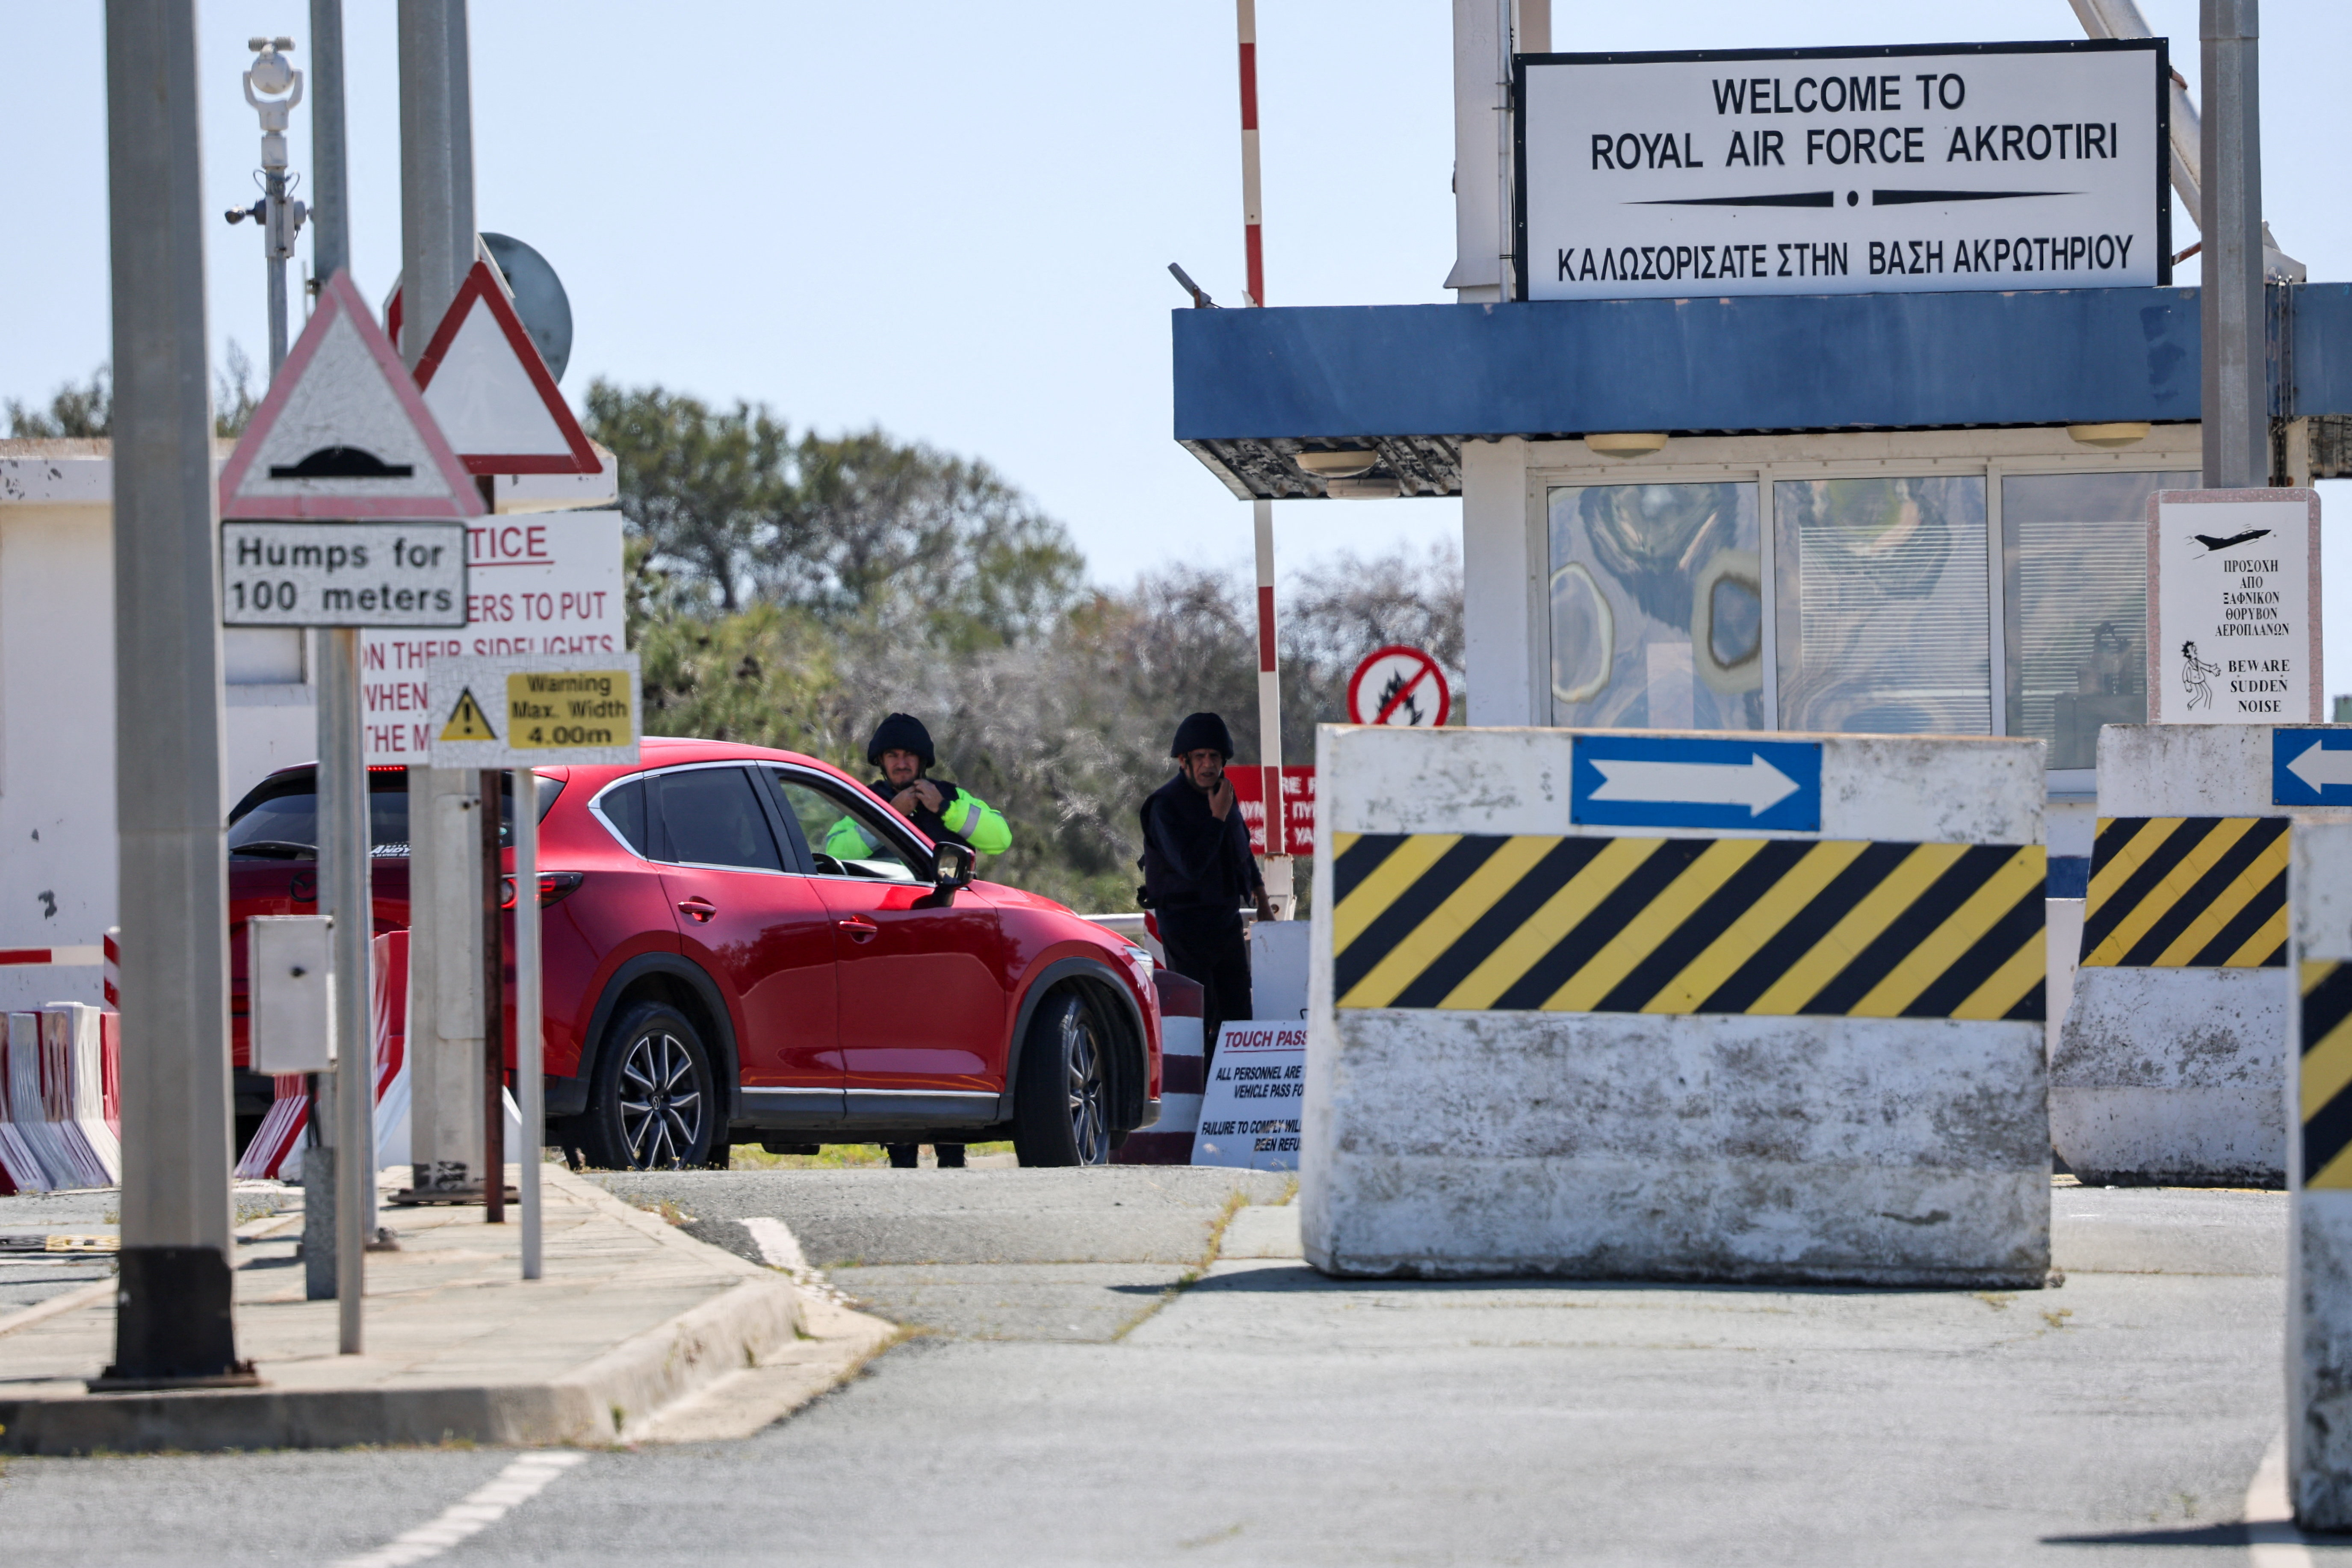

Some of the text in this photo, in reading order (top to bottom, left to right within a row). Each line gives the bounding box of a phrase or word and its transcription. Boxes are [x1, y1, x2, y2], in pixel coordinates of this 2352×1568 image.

[1712, 73, 1965, 115] WELCOME TO
[1592, 122, 2117, 170] ROYAL AIR FORCE AKROTIRI
[1558, 234, 2133, 282] ΚΑΛΩΣΟΡΙΣΑΤΕ ΣΤΗΝ ΒΑΣΗ ΑΚΡΩΤΗΡΙΟΥ
[466, 526, 547, 558] TICE
[237, 537, 443, 573] Humps for
[2224, 560, 2278, 573] ΠΡΟΣΟΧΗ
[2240, 576, 2263, 588] ΑΠΟ
[232, 580, 452, 612] 100 meters
[2223, 591, 2279, 604] ΞΑΦΝΙΚΟΝ
[521, 593, 553, 620] TO
[561, 591, 606, 620] PUT
[2225, 608, 2277, 620] ΘΟΡΥΒΟΝ
[2215, 623, 2289, 636] ΑΕΡΟΠΛΑΝΩΝ
[2228, 659, 2290, 672] BEWARE
[527, 674, 611, 696] Warning
[2231, 679, 2287, 692] SUDDEN
[512, 700, 628, 718] Max. Width
[2238, 700, 2281, 712] NOISE
[527, 726, 612, 744] 4.00m
[1225, 1030, 1273, 1048] TOUCH
[1216, 1065, 1302, 1081] ALL PERSONNEL ARE
[1234, 1084, 1304, 1098] VEHICLE PASS FO
[1201, 1121, 1236, 1136] FAILURE
[1238, 1120, 1249, 1134] TO
[1250, 1119, 1284, 1134] COMPLY
[1253, 1137, 1301, 1152] BEEN REFU
